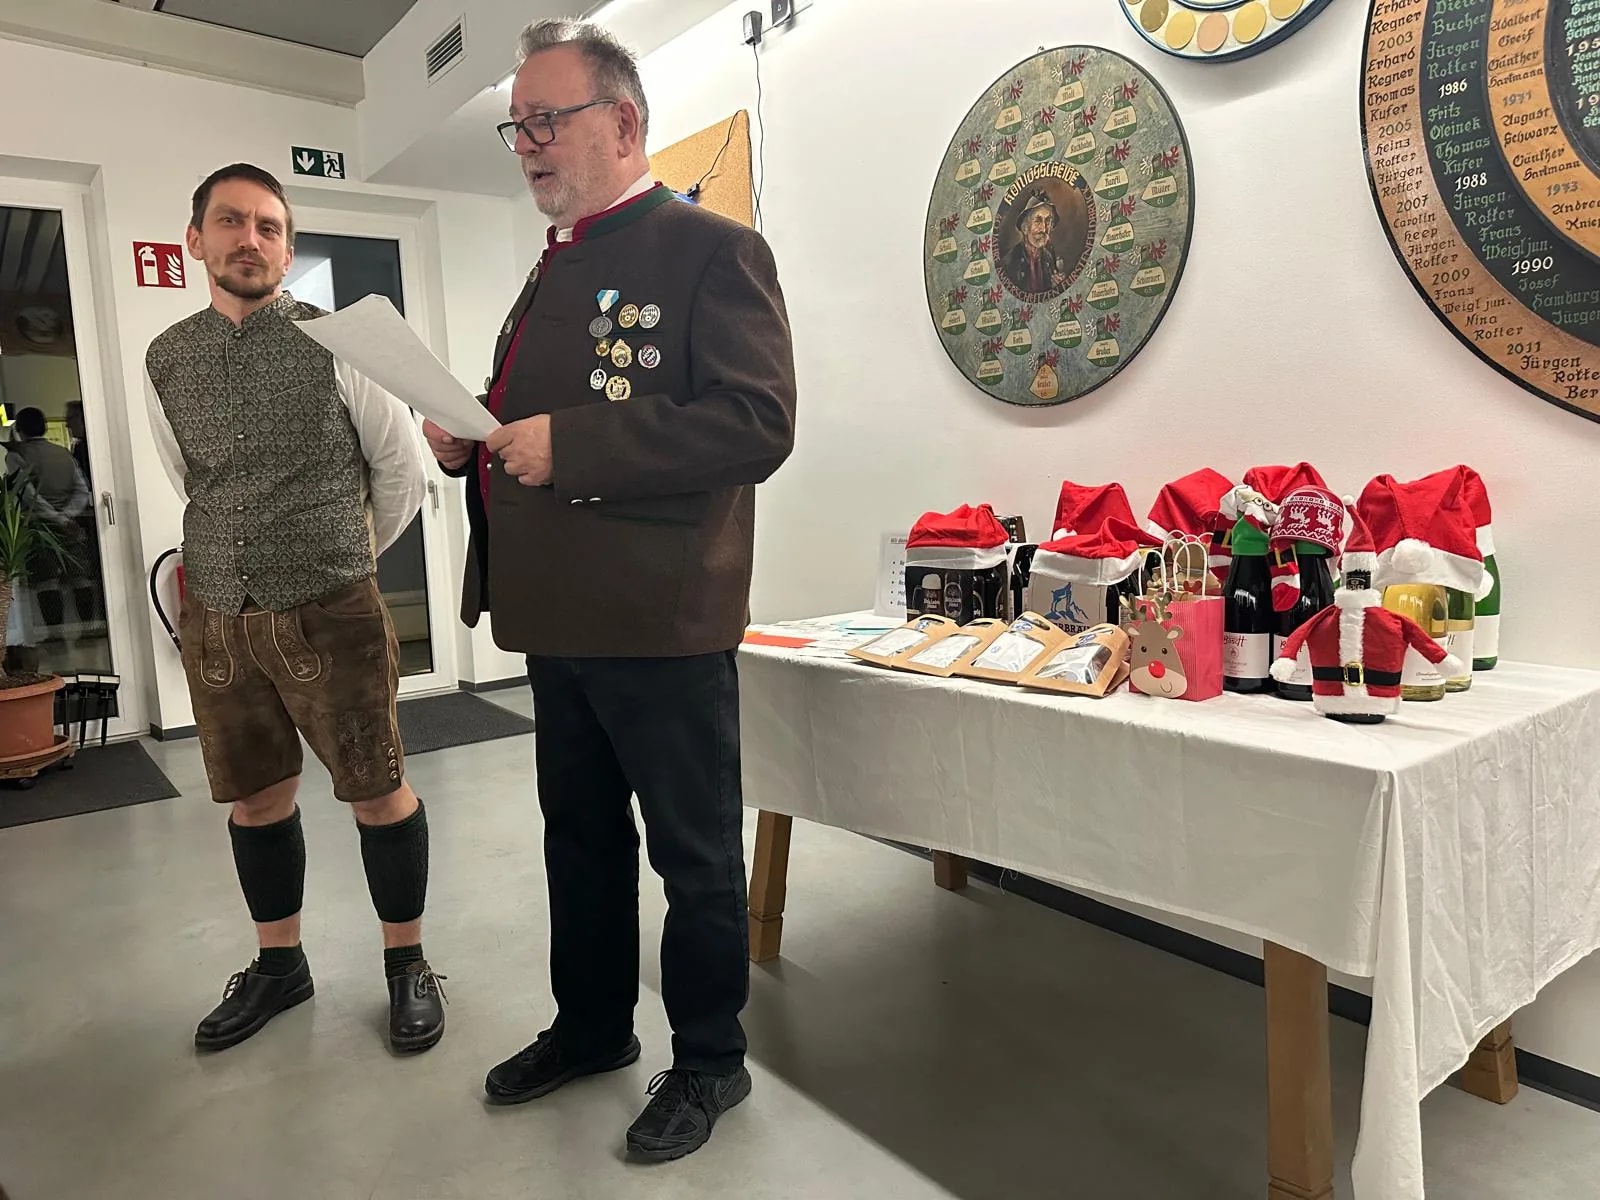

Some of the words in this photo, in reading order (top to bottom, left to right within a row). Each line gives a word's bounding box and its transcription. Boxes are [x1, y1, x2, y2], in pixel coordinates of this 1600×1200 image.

[1374, 0, 1421, 17] Erhar
[1432, 0, 1486, 18] Diete
[1370, 11, 1422, 36] Regner
[1431, 12, 1488, 37] Bucher
[1490, 8, 1545, 31] Adalbert
[1378, 31, 1413, 52] 2003
[1498, 27, 1536, 47] Greif
[1367, 46, 1416, 73] Erhard
[1426, 39, 1480, 60] Jürgen
[1367, 68, 1414, 89] Regner
[1426, 57, 1477, 80] Rotter
[1488, 68, 1544, 88] Hartmann
[1367, 84, 1416, 106] Thomas
[1438, 78, 1468, 99] 1986
[1370, 103, 1408, 122] Kufer
[1427, 101, 1461, 122] Fritz
[1500, 107, 1551, 127] August
[1379, 119, 1412, 138] 2005
[1504, 124, 1559, 148] Schwarz
[1374, 138, 1411, 156] Heinz
[1433, 137, 1491, 159] Thomas
[1443, 157, 1483, 175] Kufer
[1512, 147, 1565, 168] Günther
[1377, 166, 1424, 185] Jürgen
[1523, 160, 1581, 181] Hartmann
[1454, 172, 1488, 191] 1988
[1546, 180, 1579, 197] 1973
[1396, 194, 1429, 214] 2007
[1453, 192, 1506, 210] Jürgen
[1393, 212, 1436, 229] Carolin
[1464, 207, 1515, 227] Rotter
[1478, 225, 1522, 242] Franz
[1407, 239, 1456, 257] Jürgen
[1482, 238, 1524, 260] Weigl
[1524, 237, 1553, 258] jun.
[1511, 256, 1554, 276] 1990
[1432, 267, 1470, 286] 2009
[1518, 273, 1561, 291] Josef
[1434, 287, 1475, 300] Franz
[1442, 298, 1480, 315] Weigl
[1485, 296, 1512, 312] jun.
[1465, 312, 1498, 328] Nina
[1507, 341, 1541, 356] 2011
[1520, 354, 1581, 371] Jürgen
